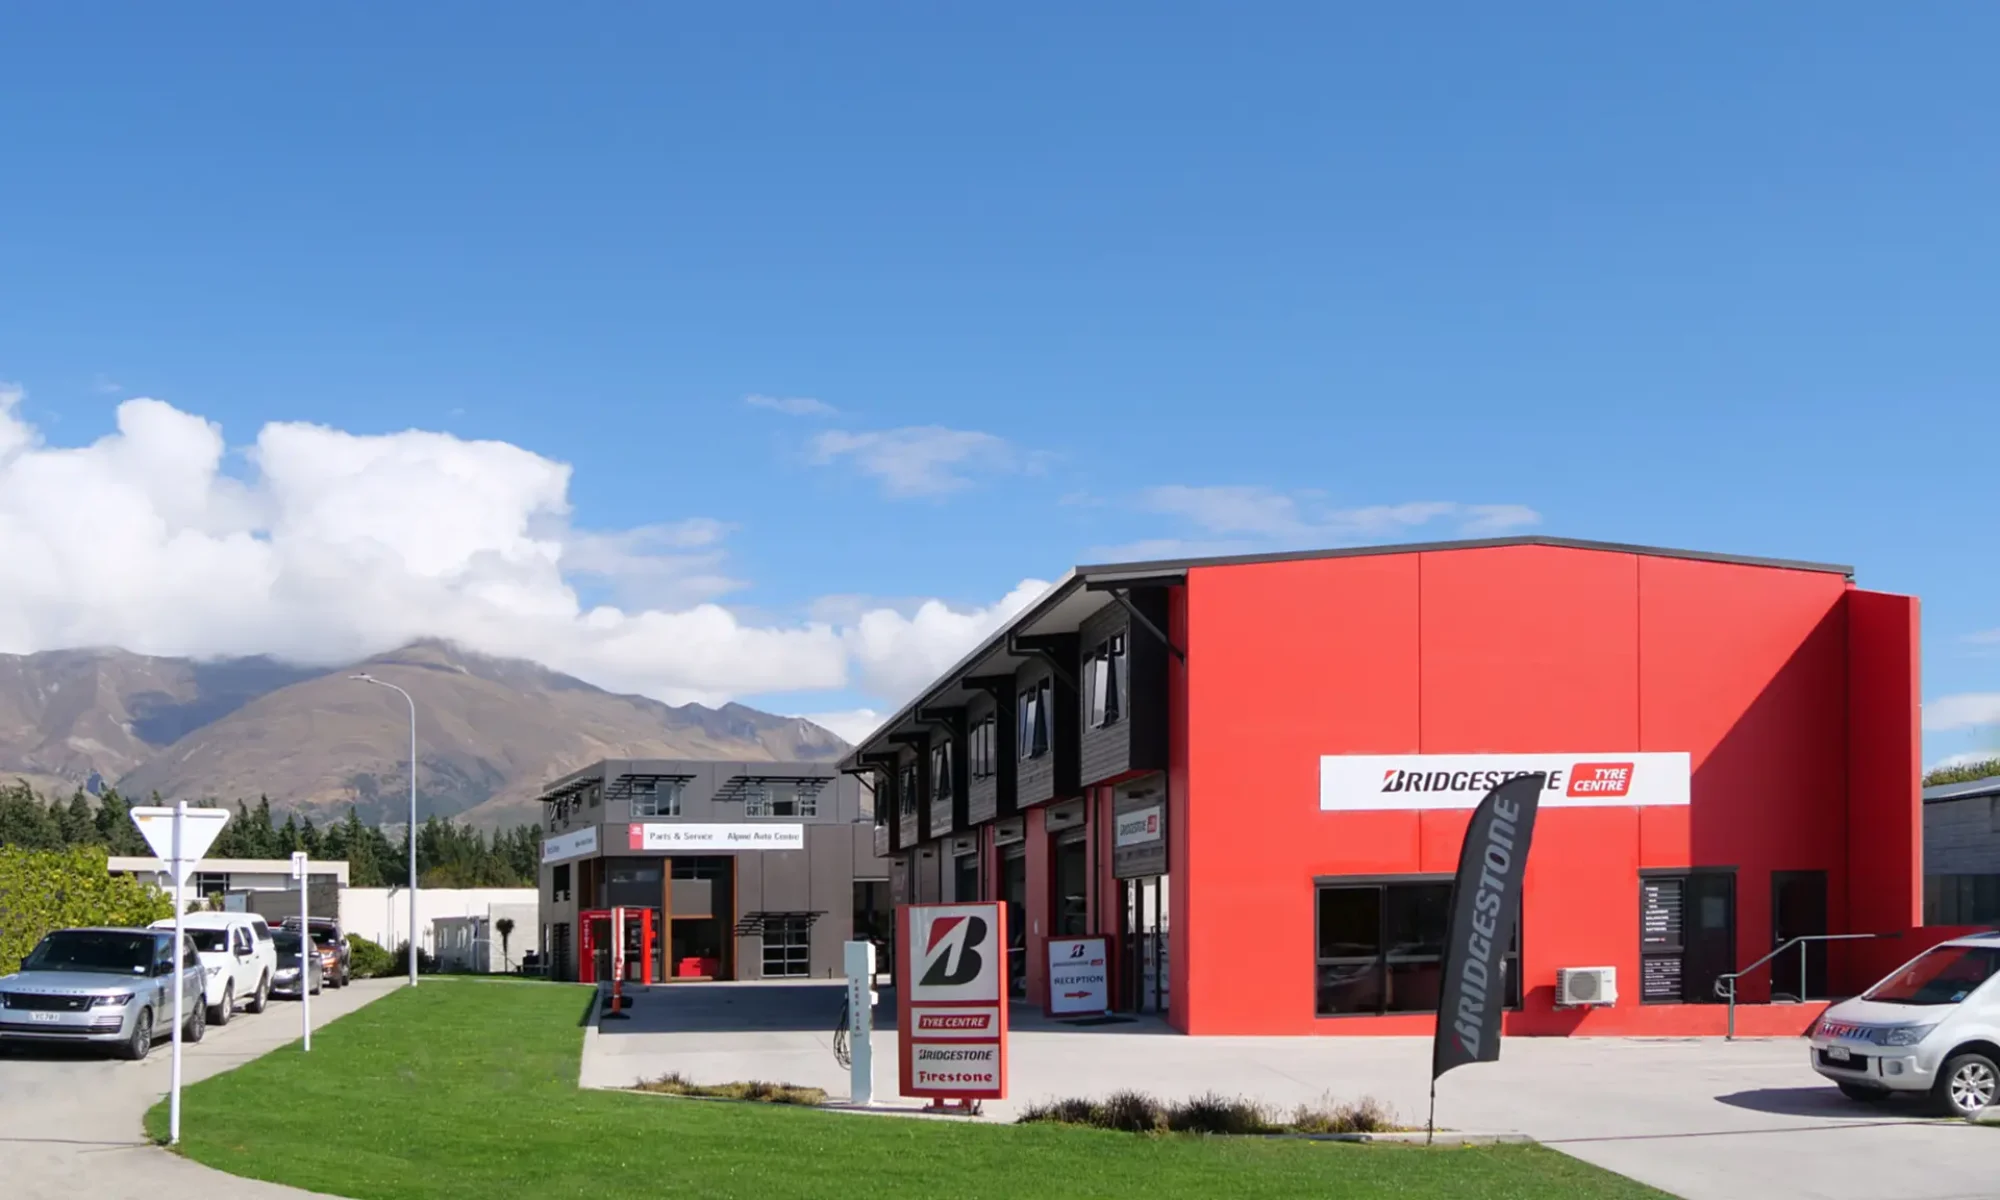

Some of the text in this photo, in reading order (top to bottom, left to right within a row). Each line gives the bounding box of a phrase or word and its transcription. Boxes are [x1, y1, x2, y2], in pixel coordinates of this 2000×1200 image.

[1595, 767, 1628, 780] TYRE
[1573, 780, 1625, 792] CENTRE
[650, 832, 671, 841] Parts
[673, 832, 681, 841] &
[683, 832, 713, 841] Service
[1452, 794, 1520, 1060] BRIDGESTONE
[1053, 975, 1104, 985] RECEPTION
[922, 1016, 985, 1028] TYRE CENTRE
[918, 1048, 993, 1061] BRIDGESTONE
[918, 1070, 993, 1084] Firestone
